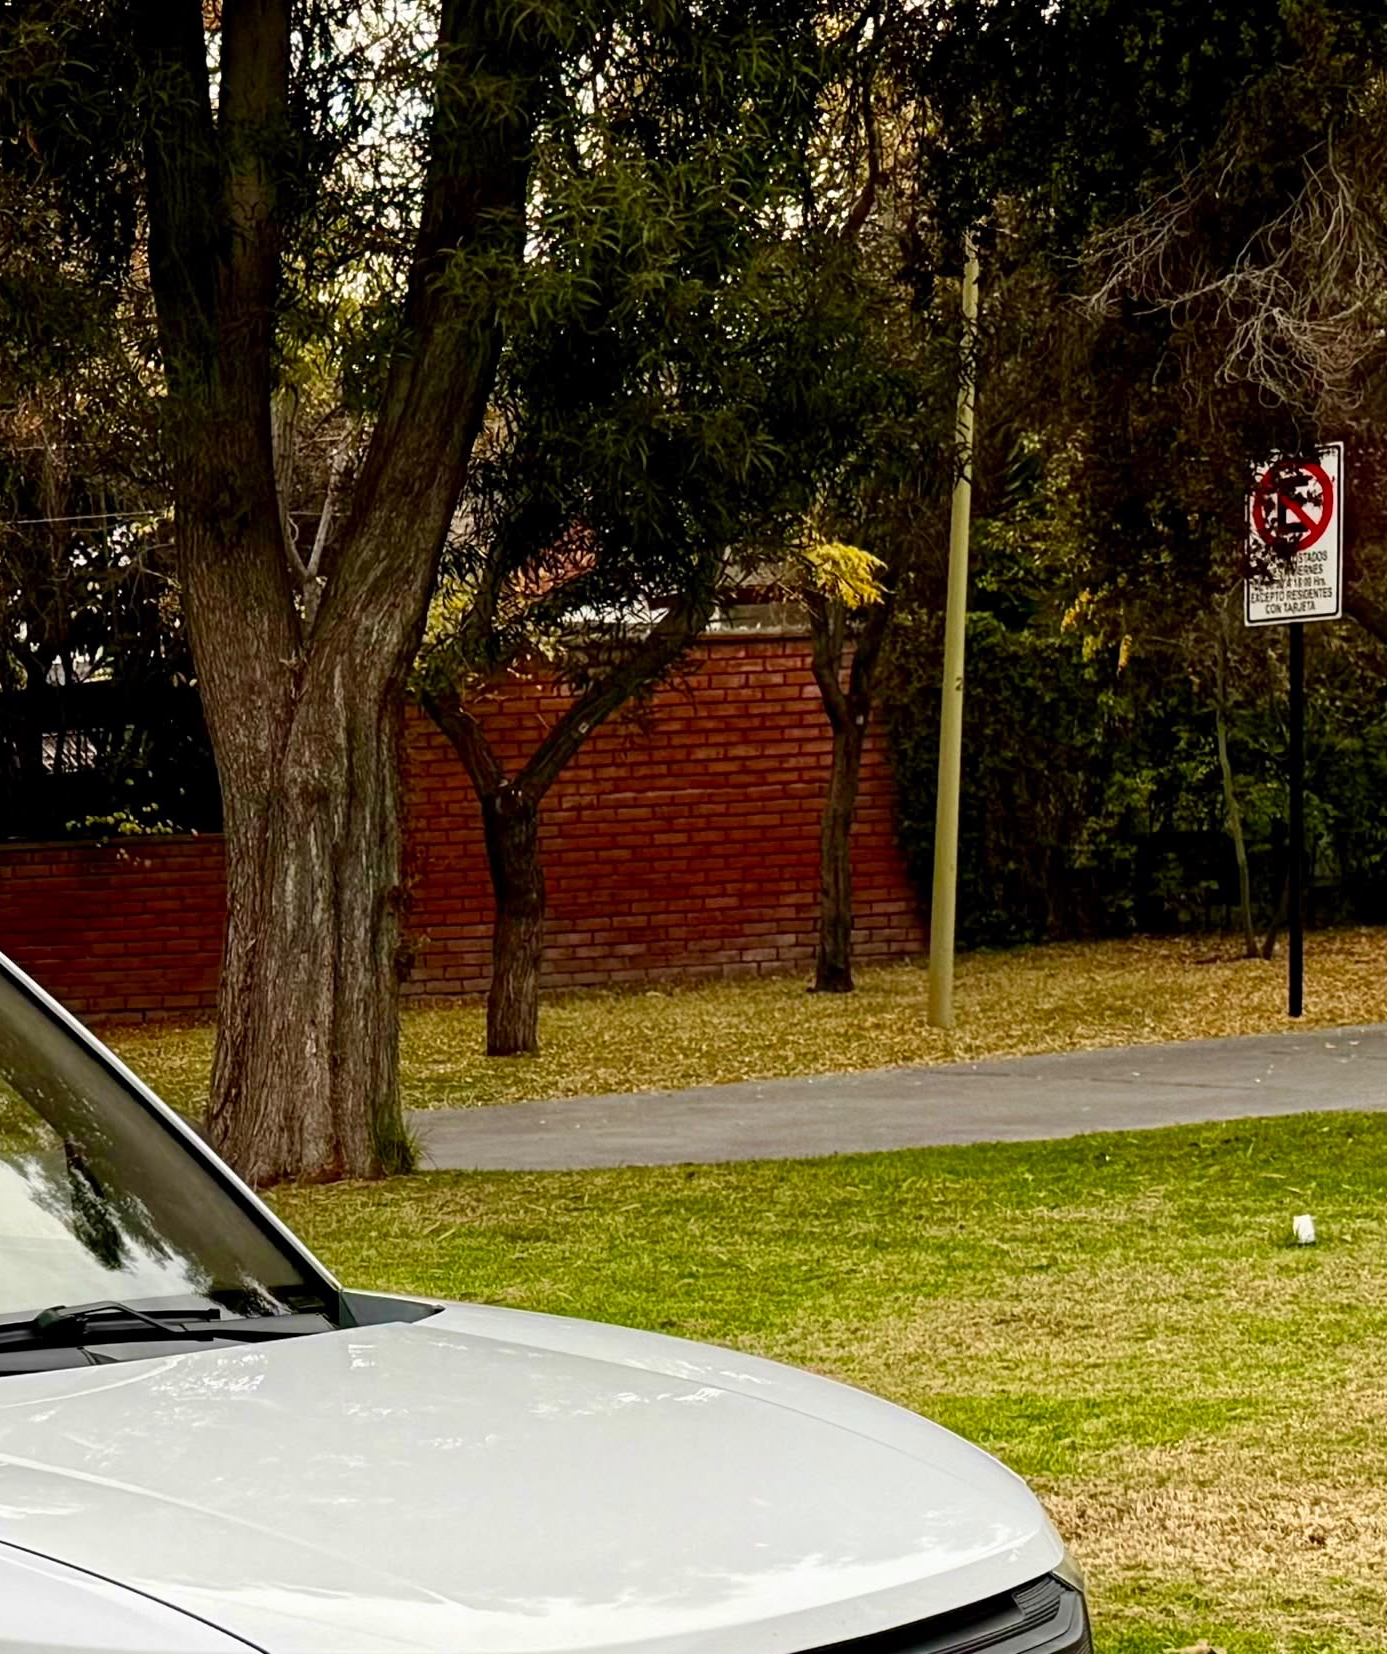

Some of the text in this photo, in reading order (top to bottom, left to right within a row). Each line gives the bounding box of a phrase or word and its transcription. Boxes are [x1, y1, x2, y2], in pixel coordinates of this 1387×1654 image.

[1250, 587, 1333, 604] EXCEPTO RESIDENTES
[1265, 601, 1316, 615] CON TARJETA
